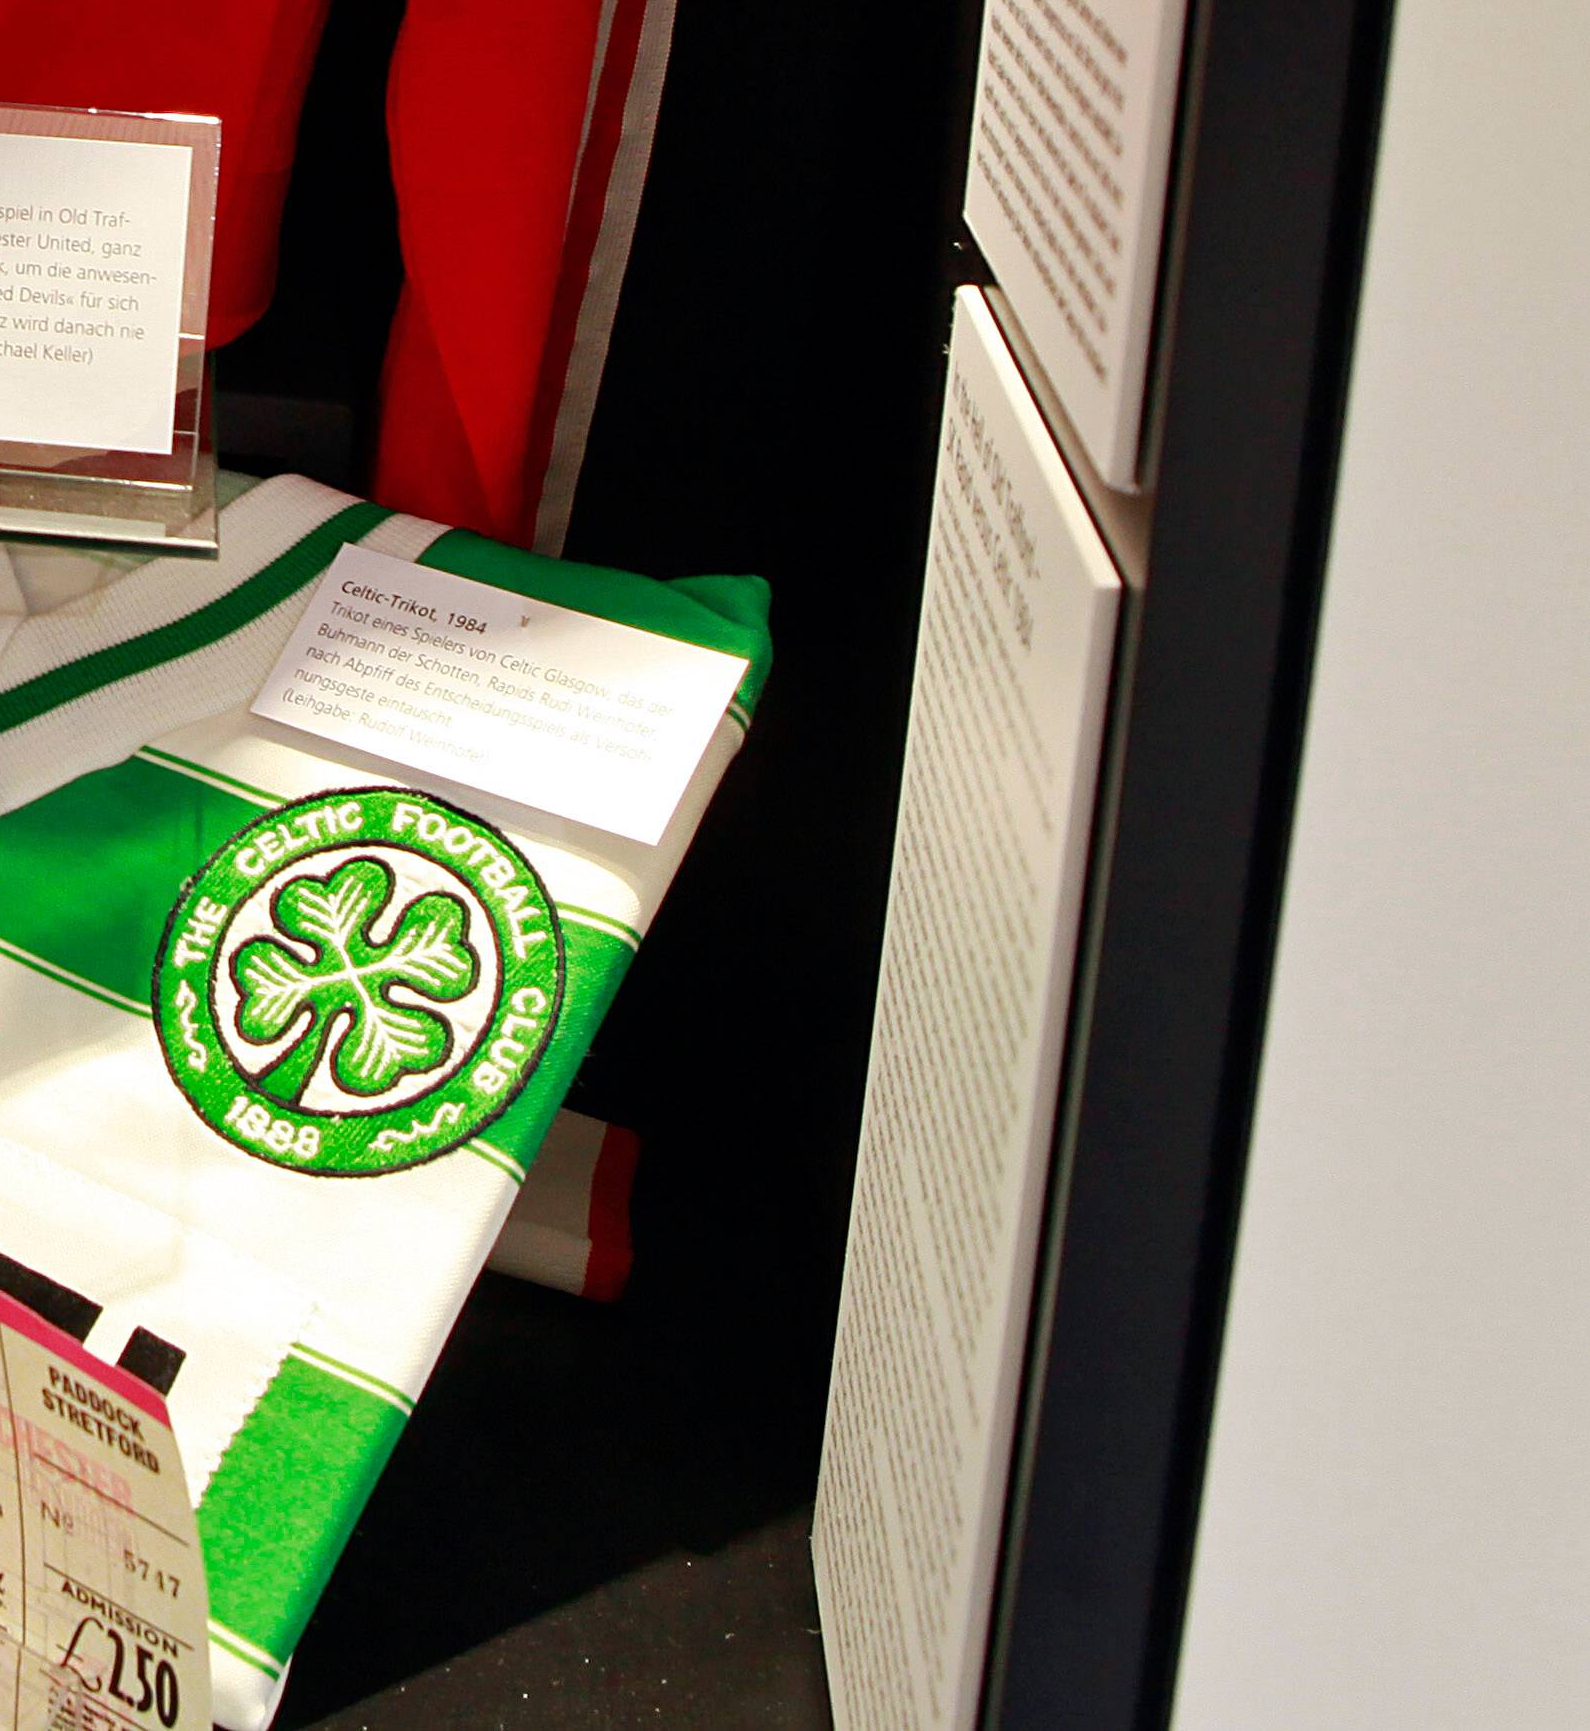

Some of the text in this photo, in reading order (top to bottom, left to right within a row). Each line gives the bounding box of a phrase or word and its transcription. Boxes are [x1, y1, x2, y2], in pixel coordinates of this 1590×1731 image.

[37, 204, 55, 227] in
[57, 207, 88, 225] Old
[91, 209, 130, 227] Traf-
[340, 580, 487, 634] Celtic-Trikot, 1984
[172, 801, 549, 1098] THE CELTIC FOOTBALL CLUB
[223, 1094, 322, 1163] 1888
[41, 1387, 160, 1474] STRETFORD
[47, 1365, 143, 1441] PADDOCK
[61, 1581, 178, 1658] ADMISSION
[56, 1617, 179, 1729] £2.50
